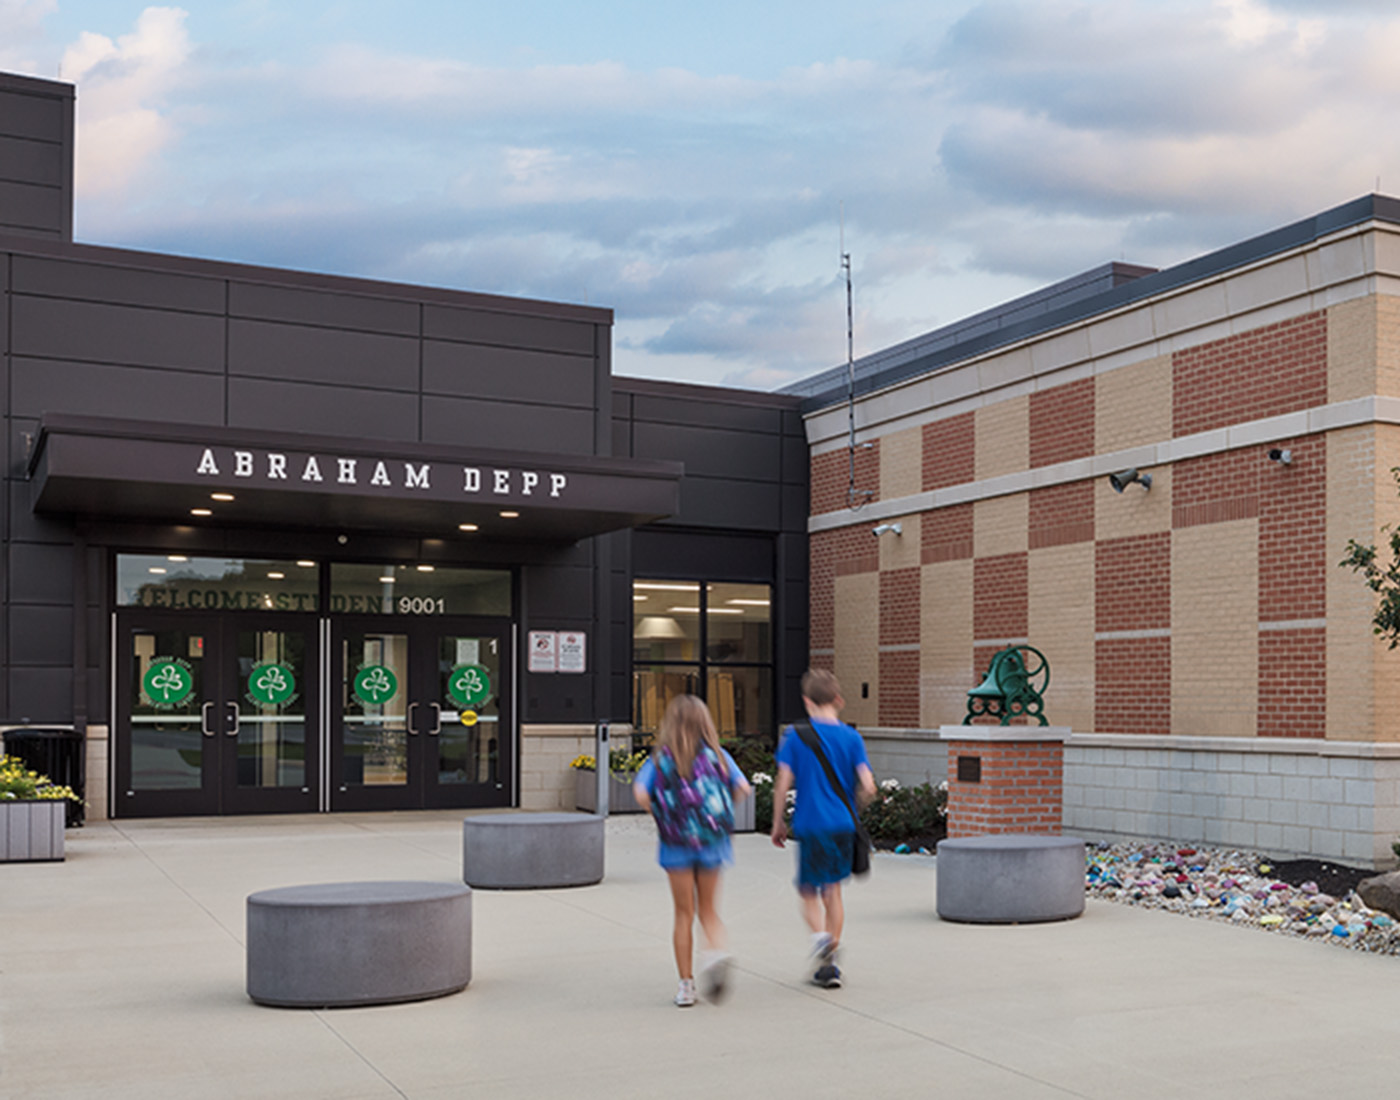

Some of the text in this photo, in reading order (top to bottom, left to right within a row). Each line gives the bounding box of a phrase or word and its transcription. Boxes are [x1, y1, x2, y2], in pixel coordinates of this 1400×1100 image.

[197, 448, 566, 497] ABRAHAM DEPP
[125, 586, 262, 611] WELCOME
[399, 596, 445, 614] 9001
[488, 638, 498, 655] 1
